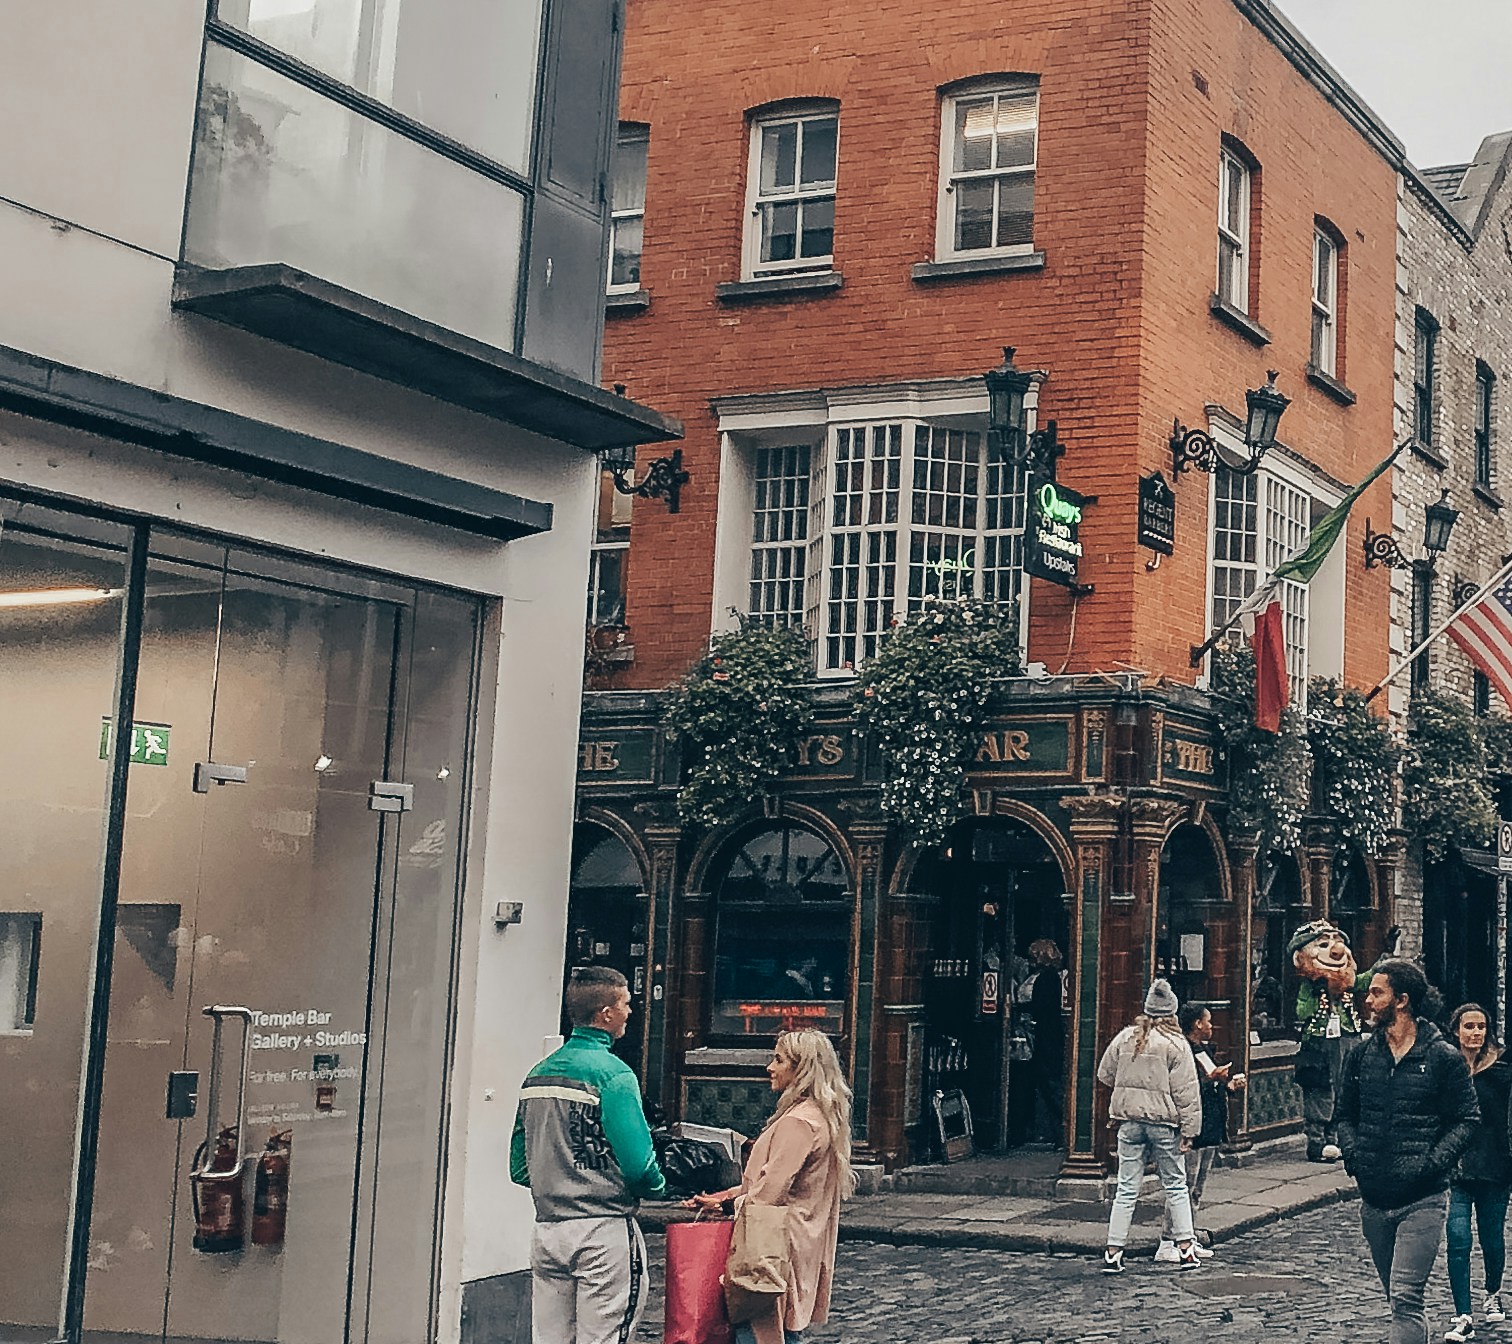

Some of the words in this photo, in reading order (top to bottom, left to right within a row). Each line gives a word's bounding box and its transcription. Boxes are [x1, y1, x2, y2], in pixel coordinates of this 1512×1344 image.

[1040, 483, 1082, 524] Quays
[1043, 551, 1076, 576] Upstairs
[974, 730, 1031, 762] AR
[251, 1010, 305, 1028] Temple
[307, 1009, 332, 1025] Bar
[251, 1033, 301, 1050] Gallery
[315, 1031, 367, 1047] Studios
[290, 1069, 308, 1081] For
